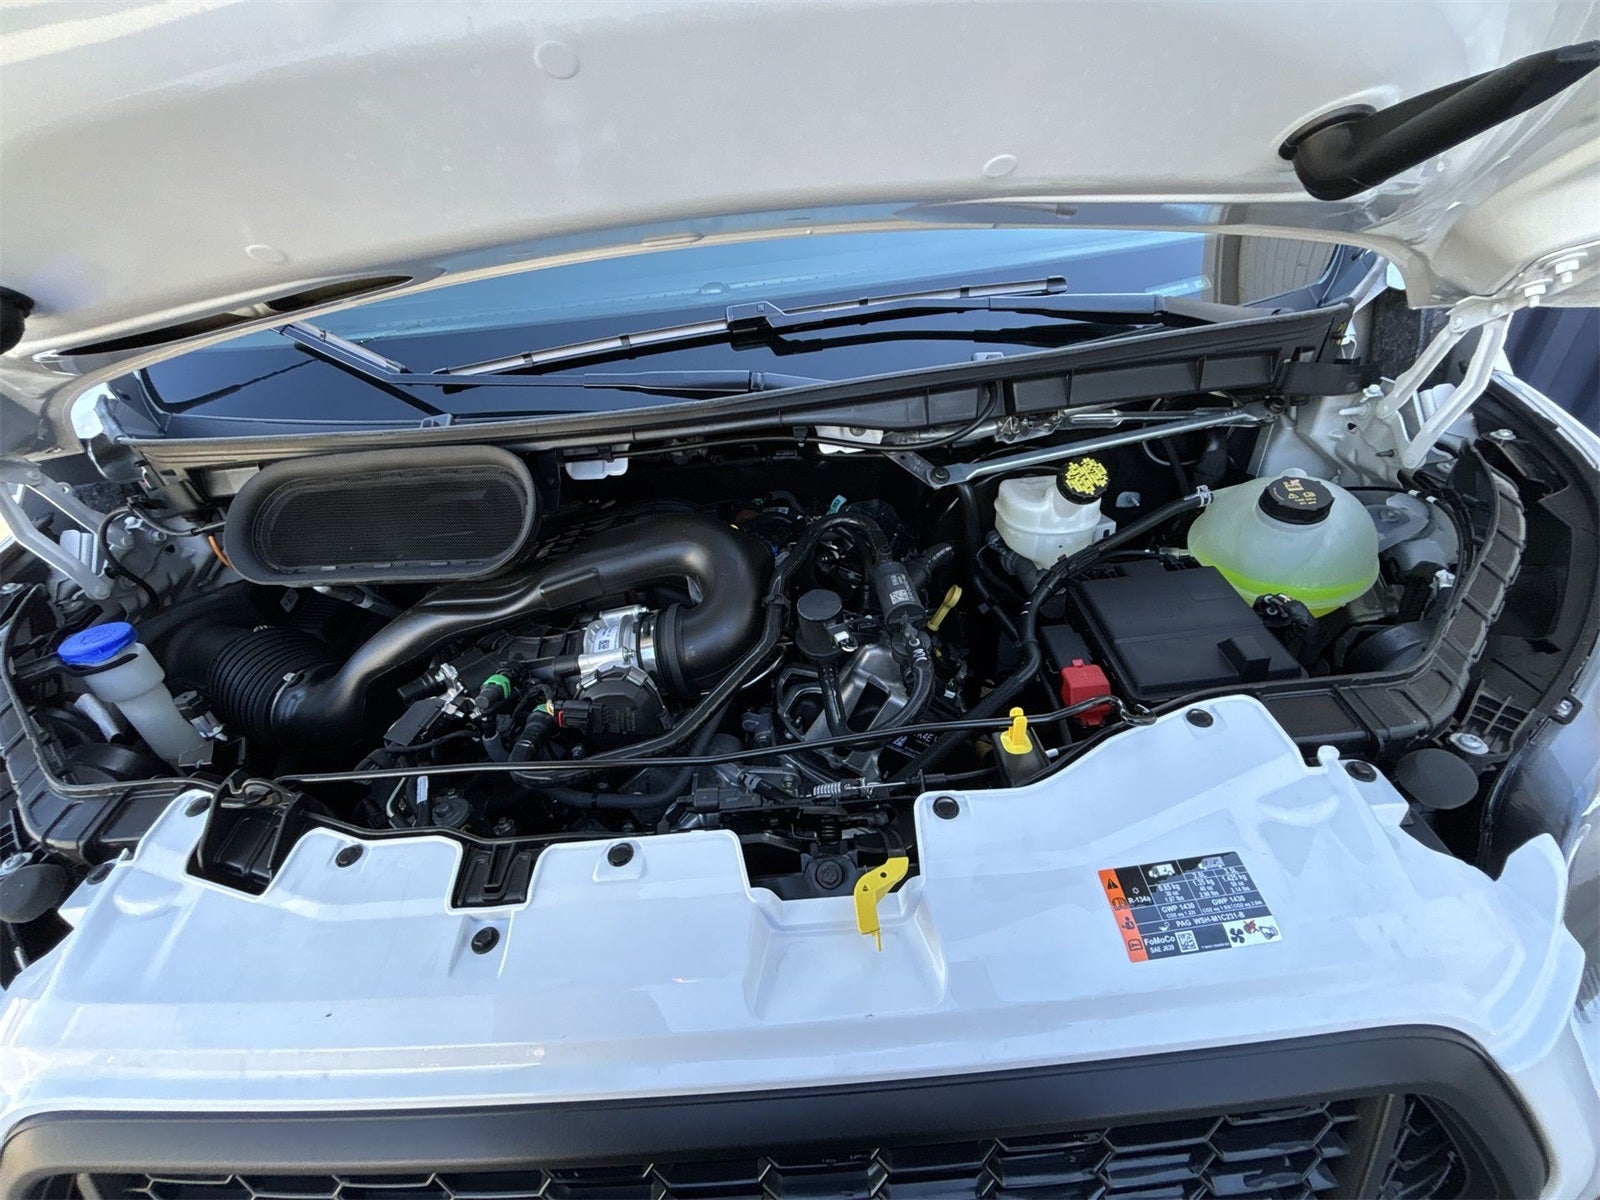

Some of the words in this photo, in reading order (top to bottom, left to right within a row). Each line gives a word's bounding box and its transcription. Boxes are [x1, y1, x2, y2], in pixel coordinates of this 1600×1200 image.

[1205, 878, 1215, 886] kg
[1238, 873, 1248, 882] kg
[1171, 882, 1181, 891] kg
[1128, 896, 1151, 905] R-134a
[1211, 897, 1228, 906] GWP
[1229, 895, 1246, 903] 1430
[1161, 904, 1178, 913] GWP
[1179, 902, 1195, 911] 1430
[1176, 919, 1192, 928] PAG
[1193, 911, 1245, 925] WSH-M1C231-B
[1143, 935, 1176, 946] FoMoCo
[1149, 946, 1162, 954] SAE
